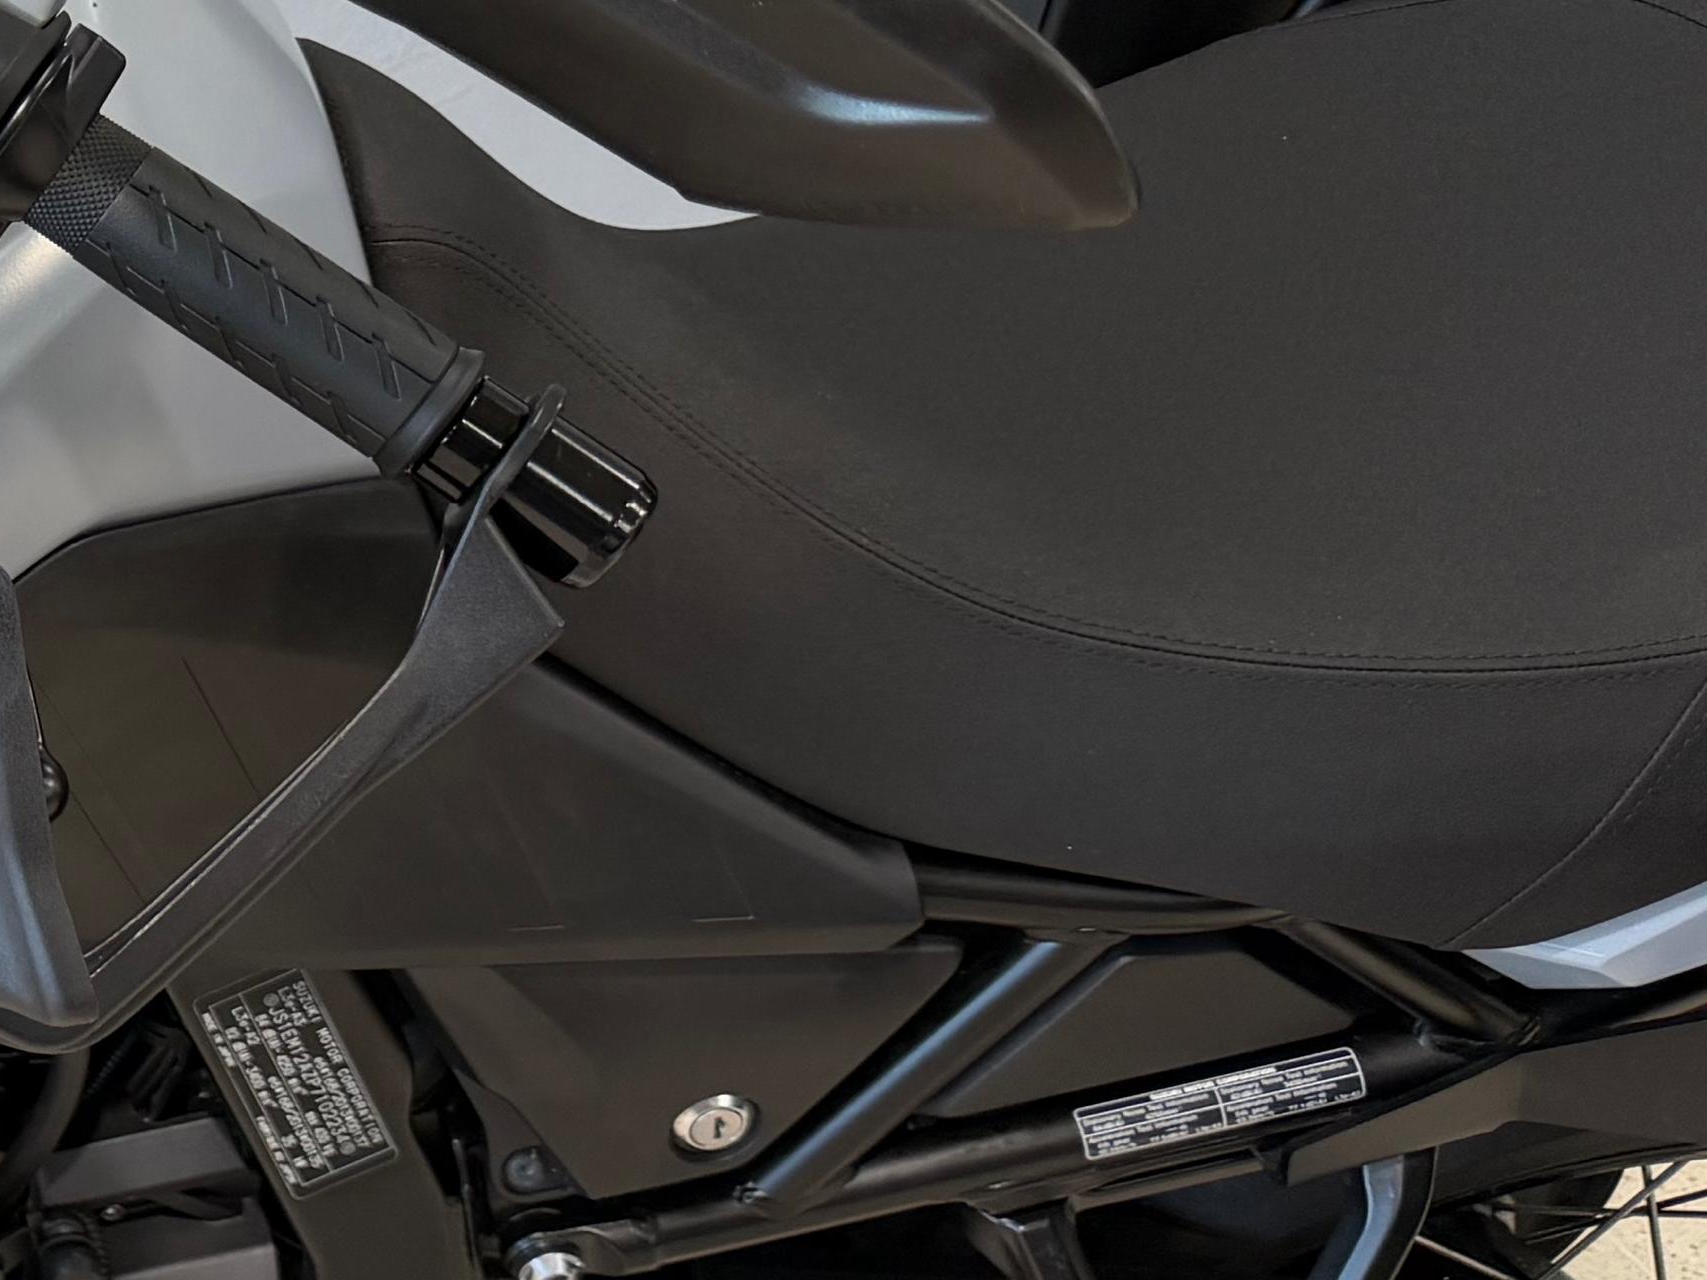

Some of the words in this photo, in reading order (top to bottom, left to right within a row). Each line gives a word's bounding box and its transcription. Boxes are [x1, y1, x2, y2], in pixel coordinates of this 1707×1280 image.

[292, 979, 322, 1024] SUZUKI
[316, 1026, 343, 1064] MOTOR
[336, 1066, 384, 1144] CORPORATION
